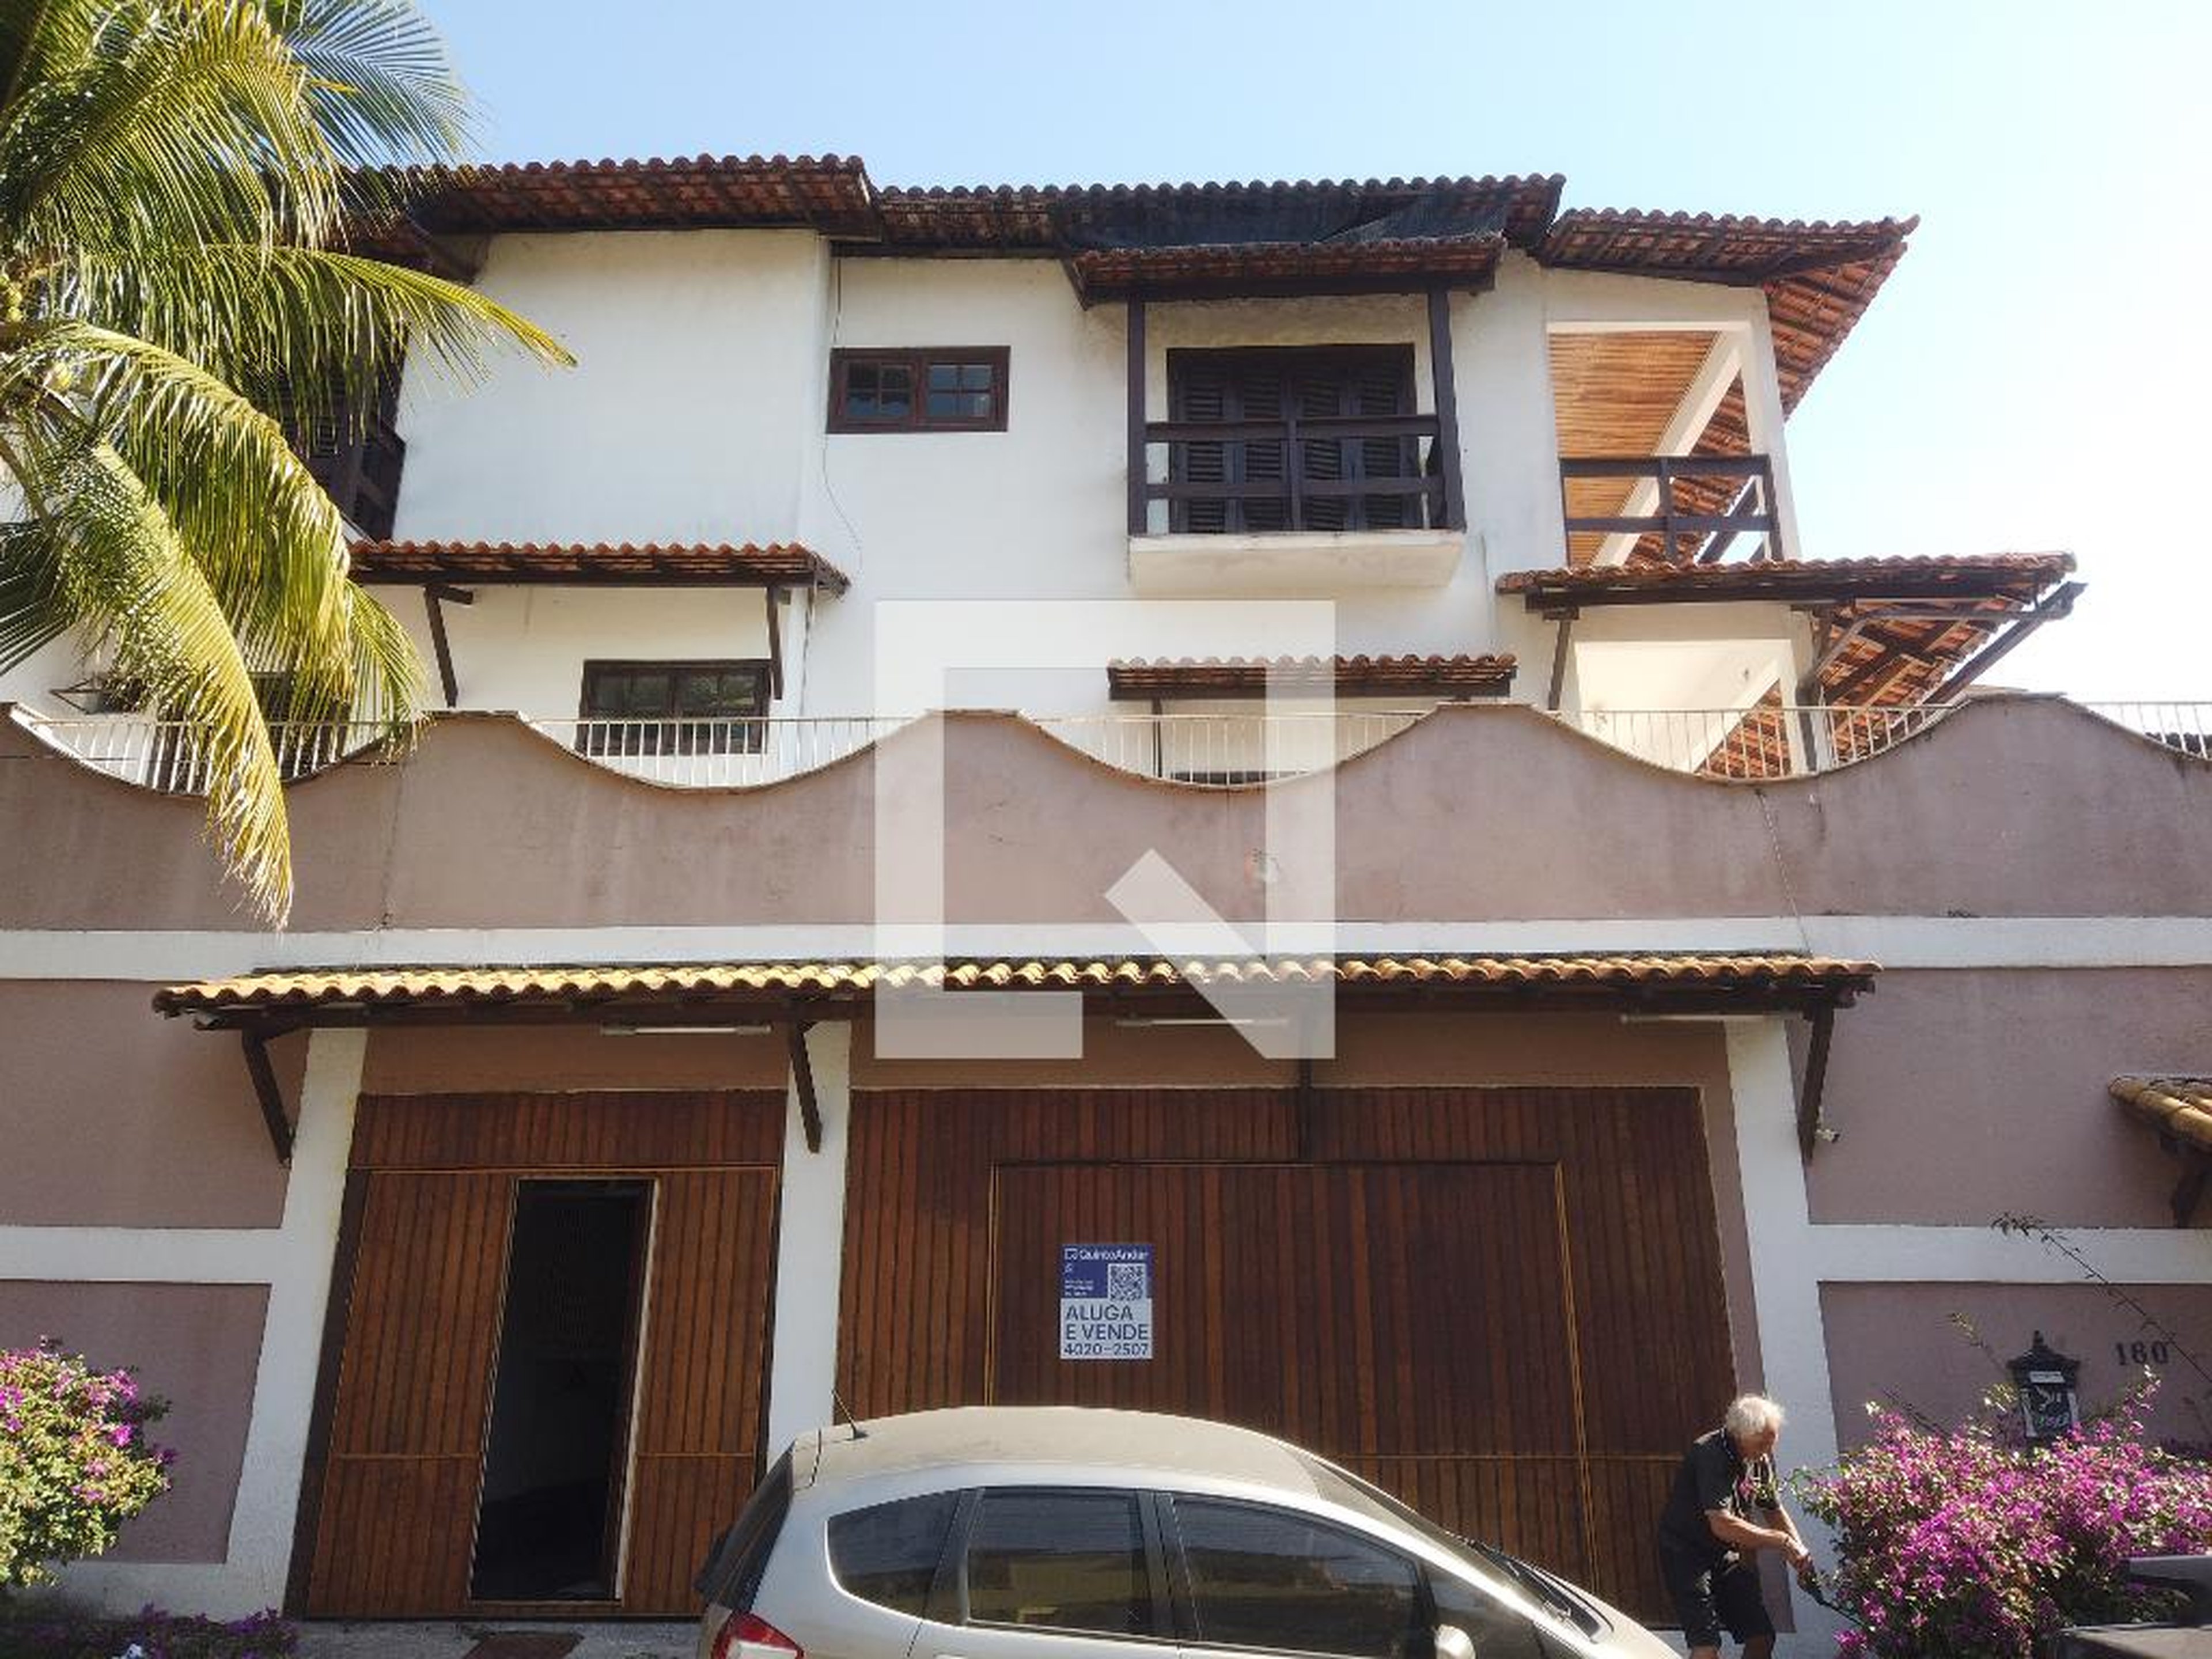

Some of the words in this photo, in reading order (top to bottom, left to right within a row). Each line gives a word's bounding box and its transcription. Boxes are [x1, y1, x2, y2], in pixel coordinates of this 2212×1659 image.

[1066, 1304, 1133, 1321] ALUGA
[1066, 1324, 1077, 1340] E
[1082, 1324, 1149, 1340] VENDE
[1065, 1343, 1149, 1355] 4020-2507
[2116, 1339, 2169, 1366] 180
